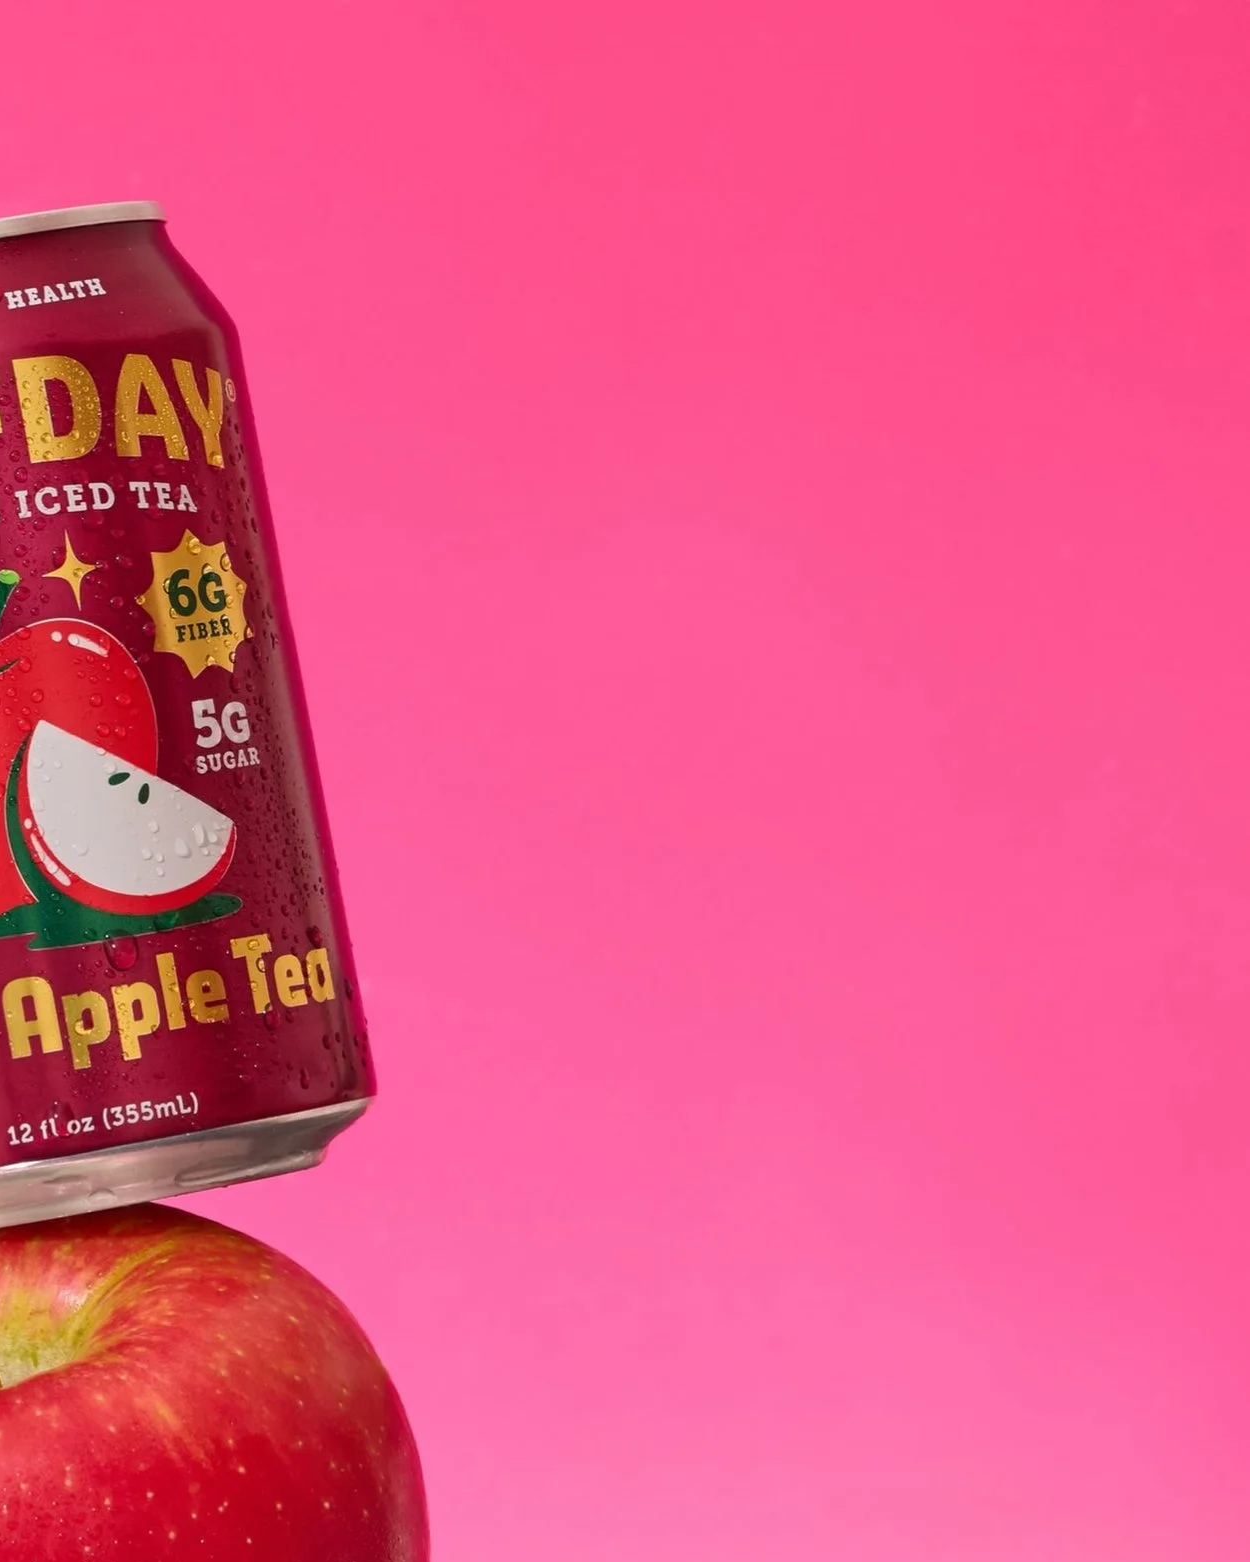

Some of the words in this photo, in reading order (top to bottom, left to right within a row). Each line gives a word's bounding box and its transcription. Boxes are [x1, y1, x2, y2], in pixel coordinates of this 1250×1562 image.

[4, 278, 107, 310] HEALTH
[15, 482, 116, 519] ICED
[129, 481, 198, 513] TEA
[168, 569, 227, 616] 6G
[175, 617, 233, 643] FIBER
[191, 698, 250, 748] 5G
[196, 747, 260, 774] SUGAR
[1, 953, 230, 1070] Apple
[230, 933, 335, 1014] Tea
[7, 1123, 34, 1145] 12
[39, 1118, 59, 1140] fl
[67, 1116, 95, 1135] oz
[102, 1092, 199, 1130] (355mL)
